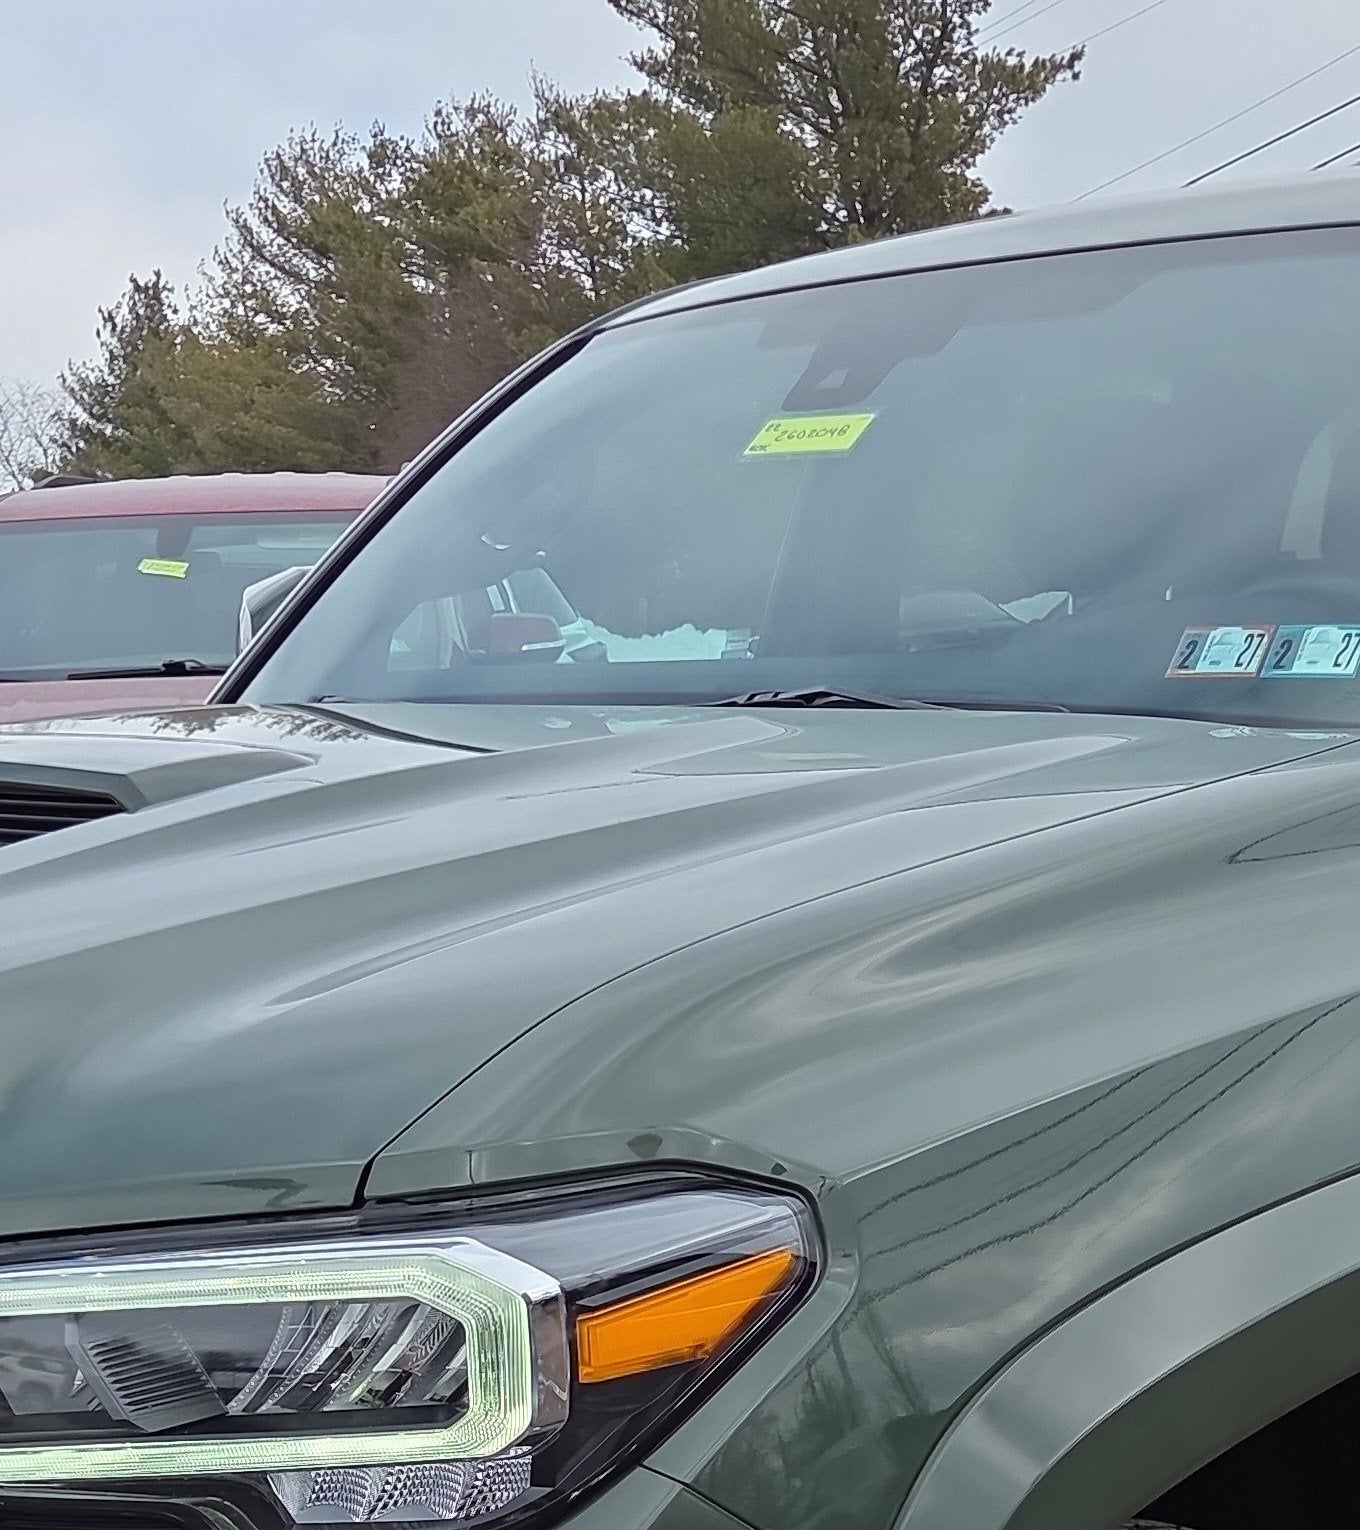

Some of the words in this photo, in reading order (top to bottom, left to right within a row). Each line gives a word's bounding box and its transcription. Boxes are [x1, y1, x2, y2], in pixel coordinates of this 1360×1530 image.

[1178, 639, 1199, 670] 2
[1234, 633, 1266, 671] 27
[1273, 639, 1293, 670] 2
